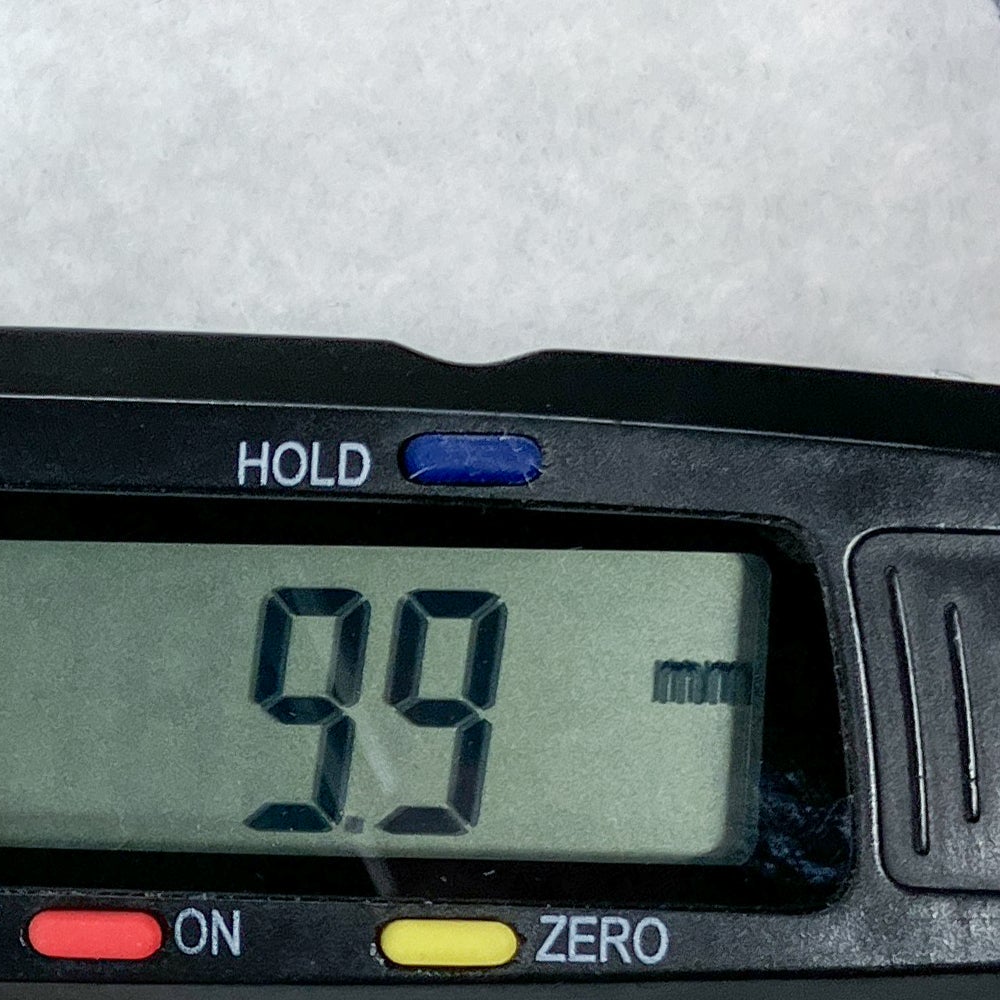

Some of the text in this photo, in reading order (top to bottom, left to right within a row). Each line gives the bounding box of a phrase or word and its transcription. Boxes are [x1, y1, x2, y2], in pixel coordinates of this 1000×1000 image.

[237, 440, 372, 488] HOLD
[242, 586, 508, 837] 9.9
[174, 907, 242, 957] ON
[534, 914, 670, 966] ZERO
